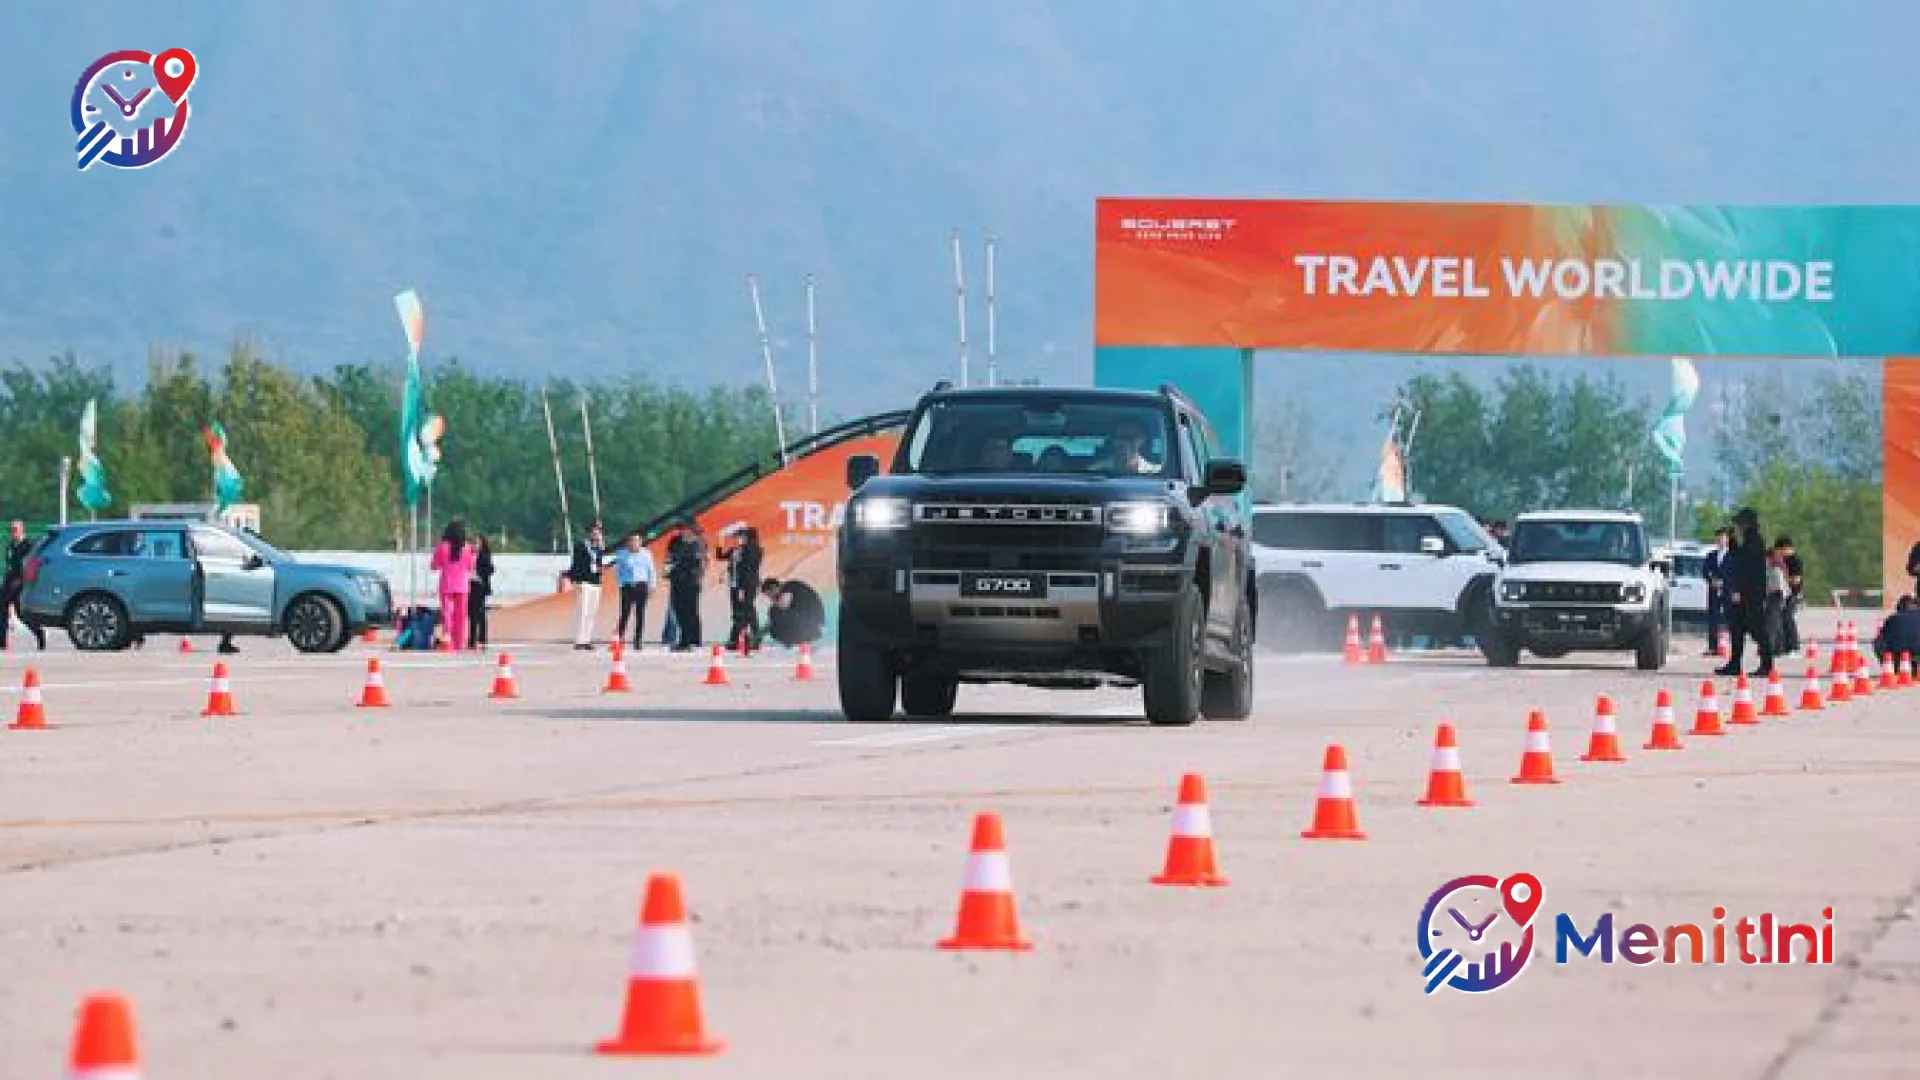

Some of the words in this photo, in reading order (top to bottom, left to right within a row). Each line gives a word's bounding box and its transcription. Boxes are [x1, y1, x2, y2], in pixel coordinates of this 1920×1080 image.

[1295, 254, 1490, 299] TRAVEL
[1501, 259, 1835, 302] WORLDWIDE
[975, 577, 1031, 591] G700
